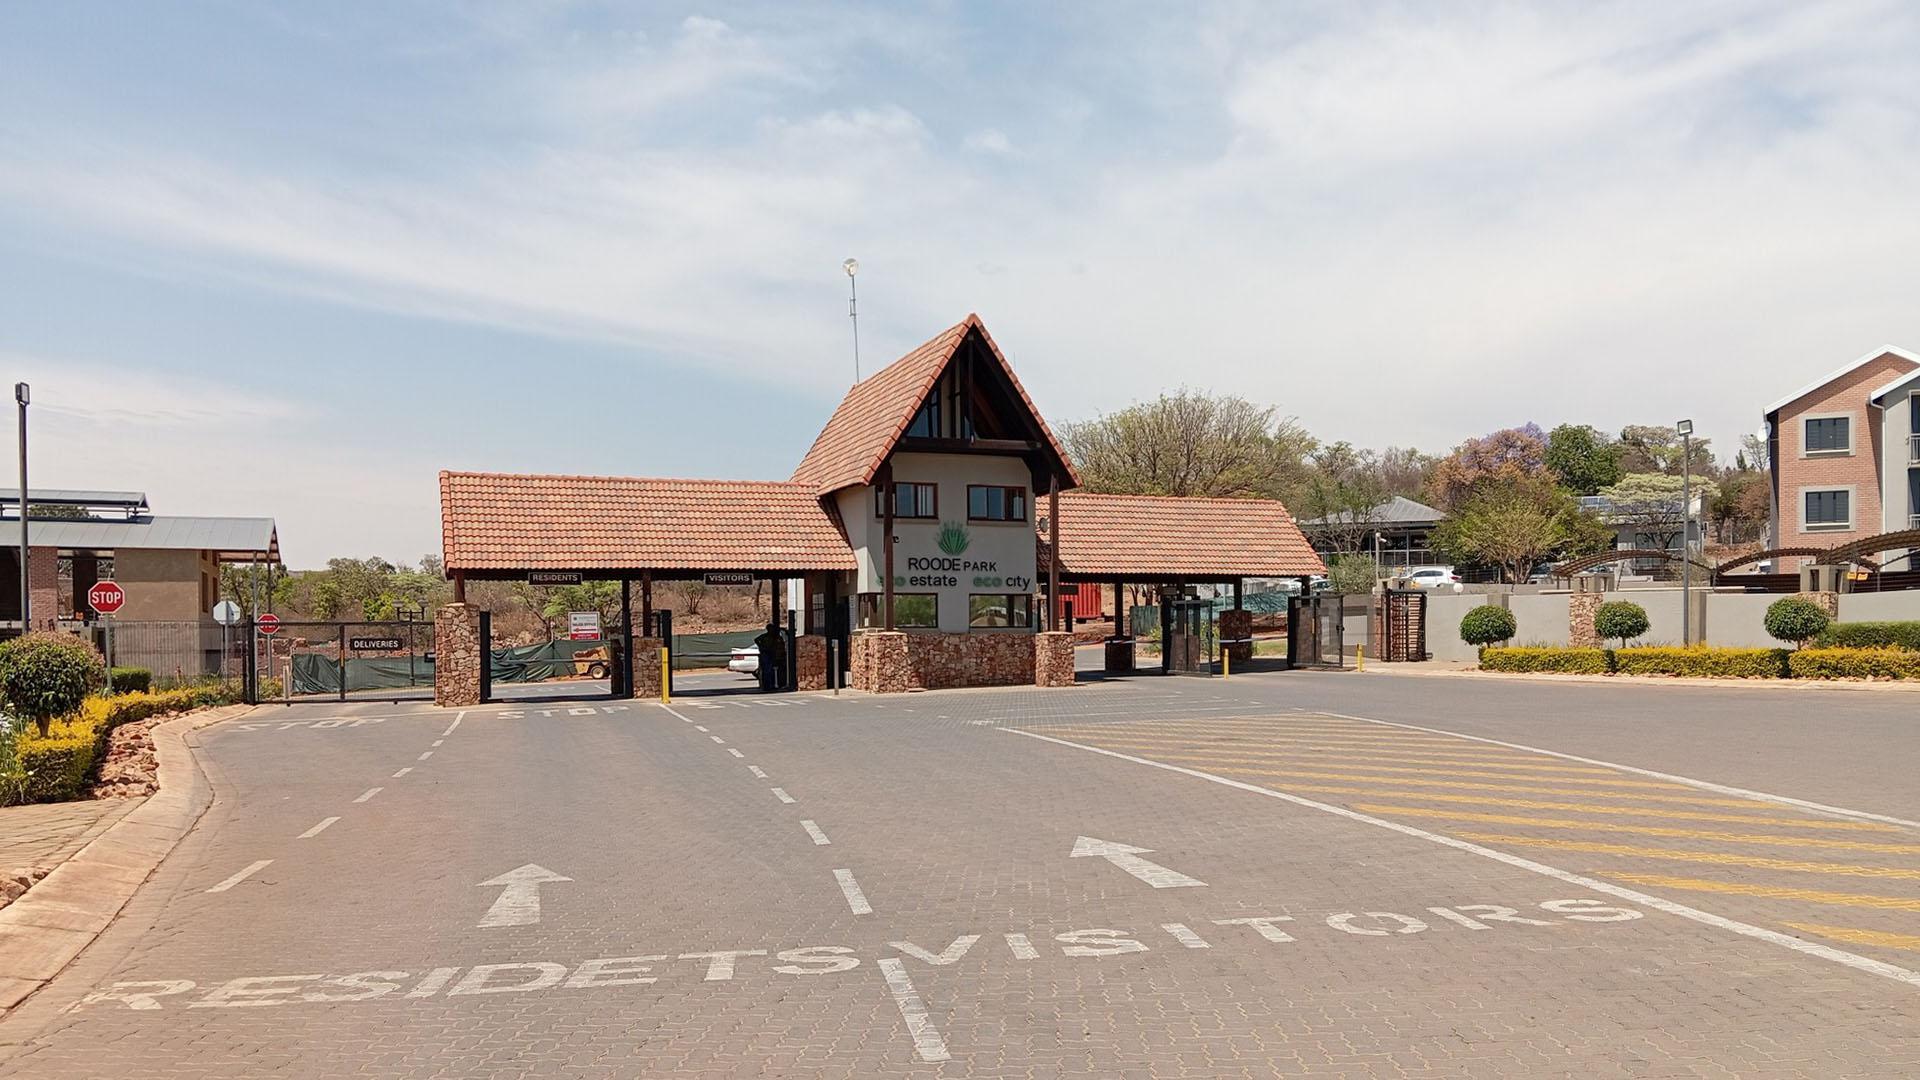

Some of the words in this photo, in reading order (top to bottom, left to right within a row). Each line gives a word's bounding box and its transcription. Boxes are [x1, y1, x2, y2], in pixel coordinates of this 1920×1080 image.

[908, 557, 961, 571] ROODE
[963, 561, 997, 572] PARK
[910, 575, 957, 587] estate
[973, 576, 1003, 588] eco
[1006, 575, 1031, 591] city
[91, 591, 121, 604] STOP
[353, 640, 399, 649] DELIVERIES
[496, 706, 630, 720] STOP
[888, 899, 1645, 966] VISITORS
[76, 945, 861, 1010] RESIDETS
